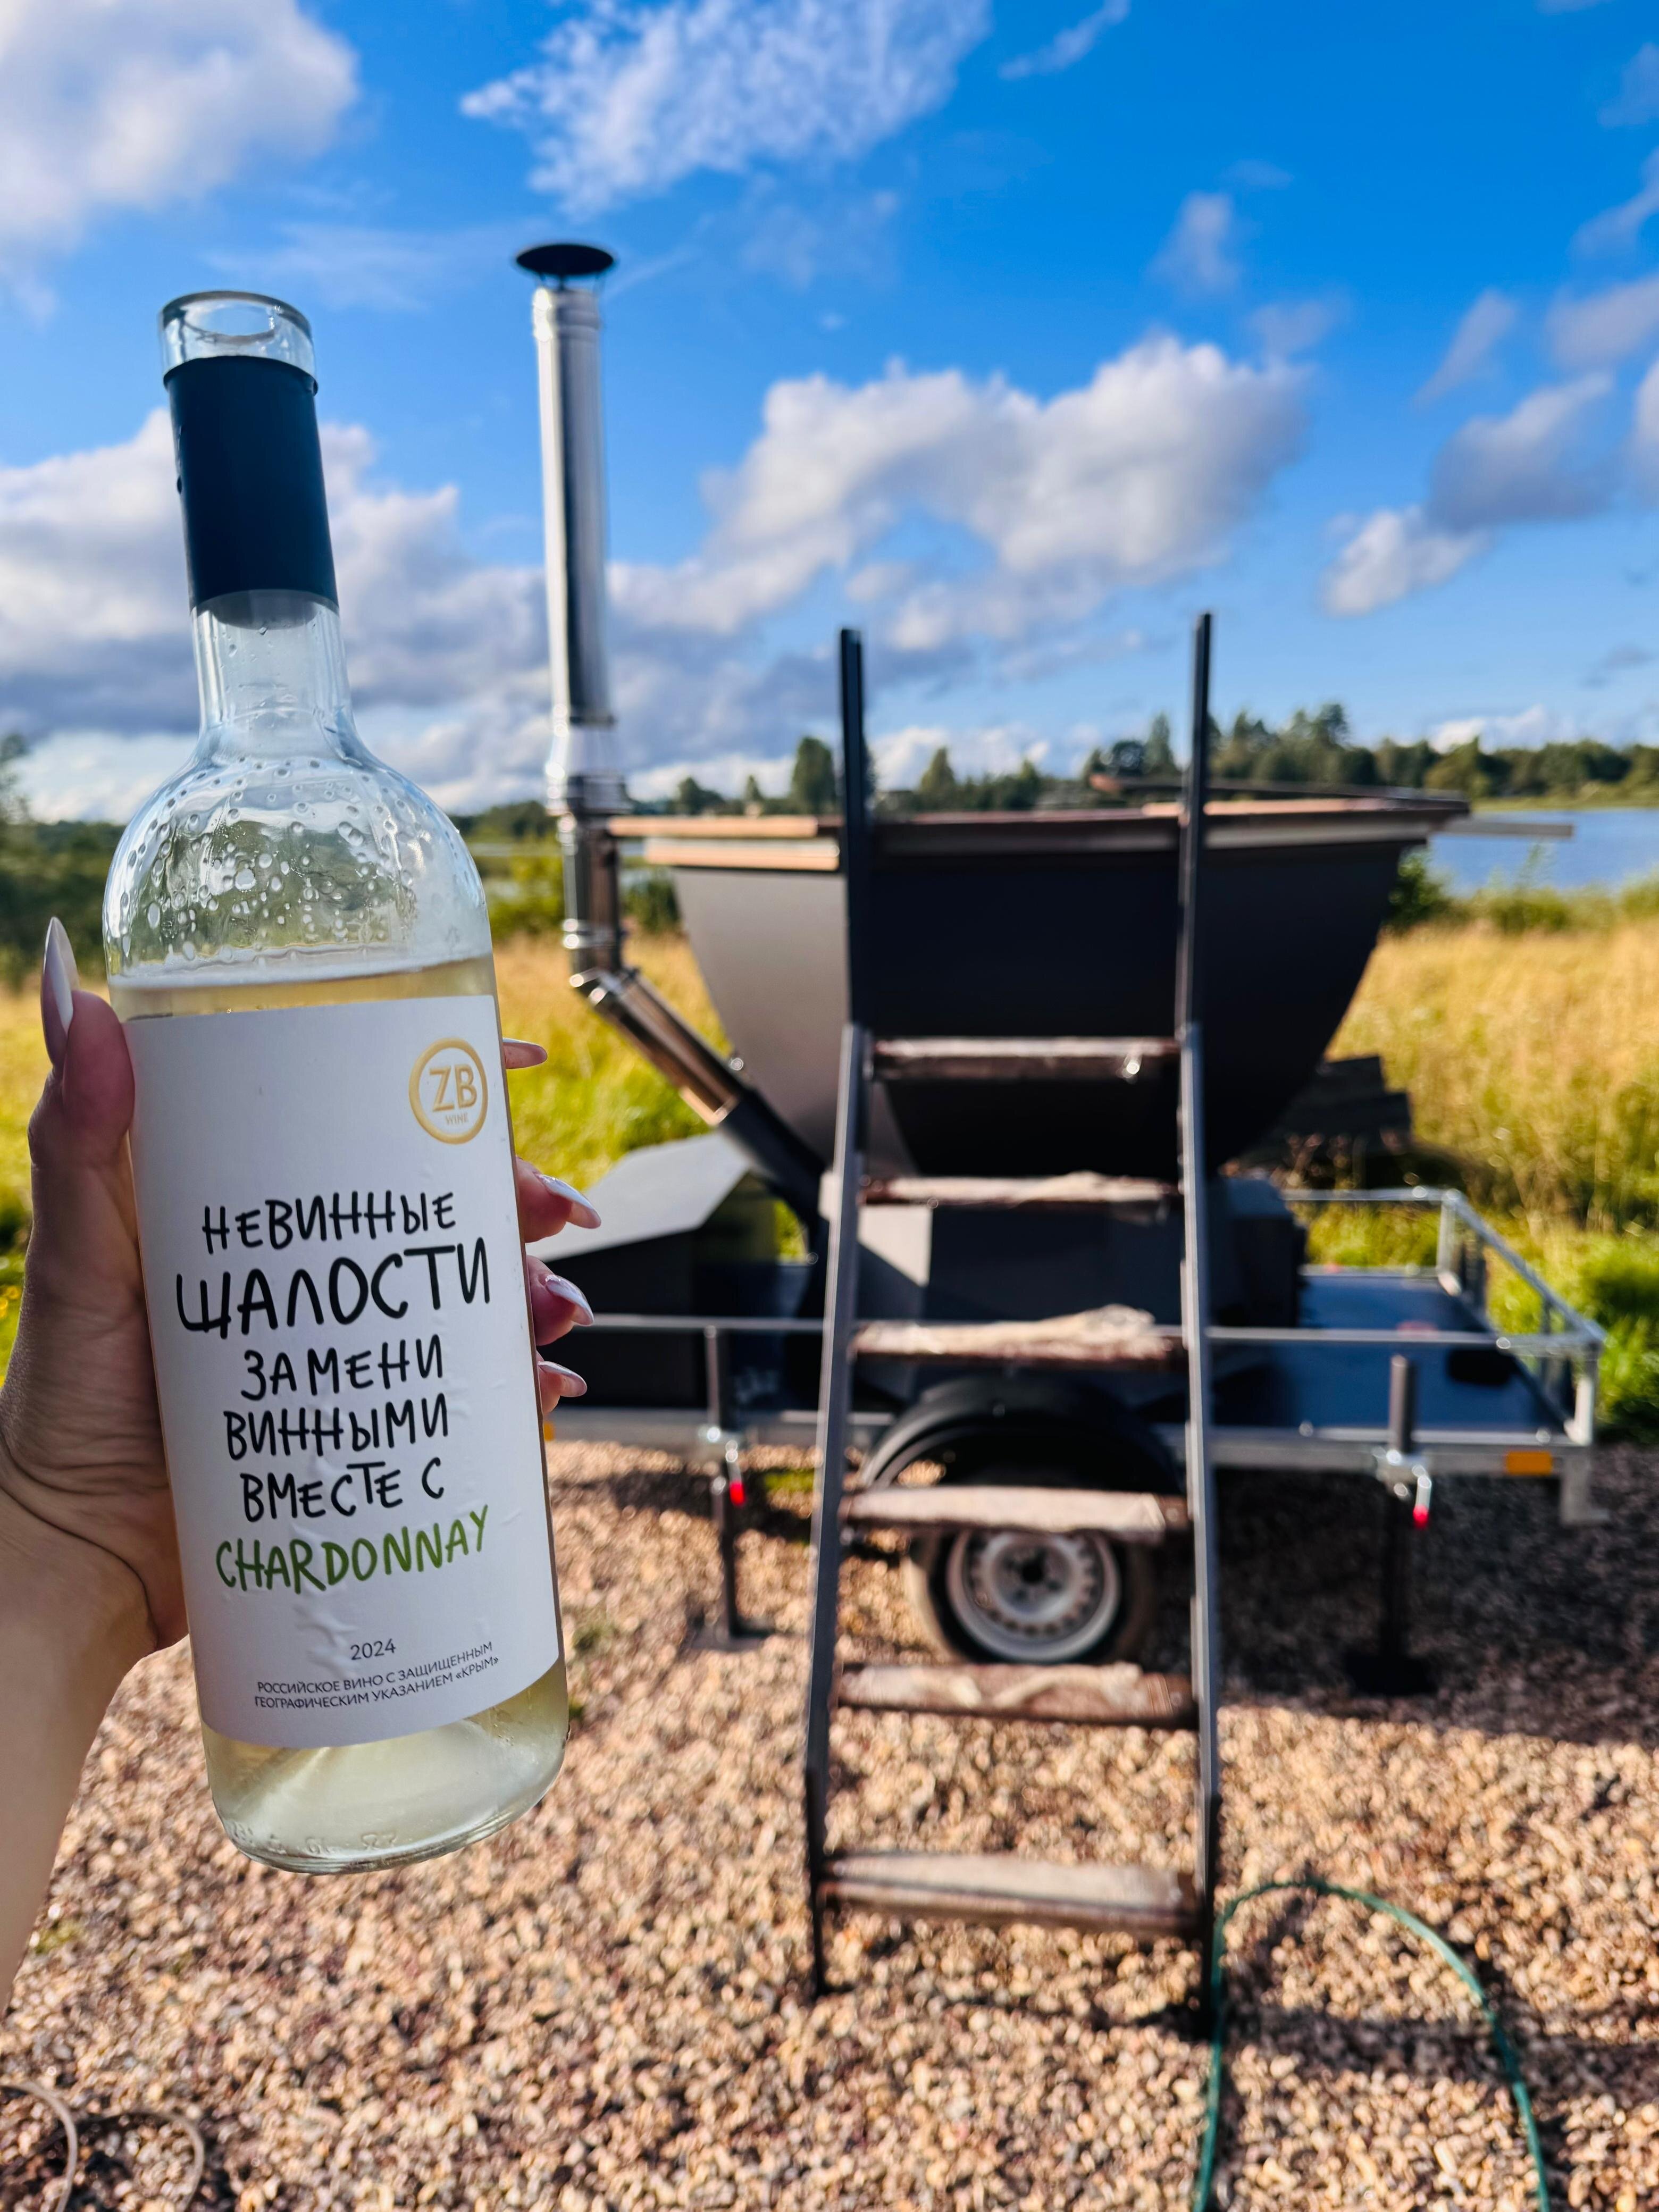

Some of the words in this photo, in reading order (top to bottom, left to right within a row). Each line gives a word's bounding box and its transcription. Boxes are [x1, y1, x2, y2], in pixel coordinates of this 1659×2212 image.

[429, 1064, 477, 1112] ZB
[445, 1112, 468, 1125] WINE
[202, 1191, 456, 1254] НЕВИННЫЕ
[176, 1237, 491, 1339] ШАЛОСТИ
[240, 1334, 443, 1401] ЗАМЕНИ
[223, 1393, 449, 1461] ВИННЫМИ
[240, 1461, 403, 1522] ВМЕСТЕ
[422, 1457, 445, 1499] С
[216, 1505, 489, 1594] CHARDONNAY
[257, 1681, 340, 1694] РОССИЙСКОЕ
[343, 1674, 383, 1690] ВИНО
[387, 1672, 396, 1683] С
[399, 1641, 493, 1681] ЗАЩИЩЕННЫМ
[350, 1638, 396, 1660] 2024
[255, 1692, 369, 1709] ГЕОГРАФИЧЕСКИМ
[372, 1672, 453, 1702] УКАЗАНИЕМ
[456, 1656, 499, 1679] «КРЫМ»
